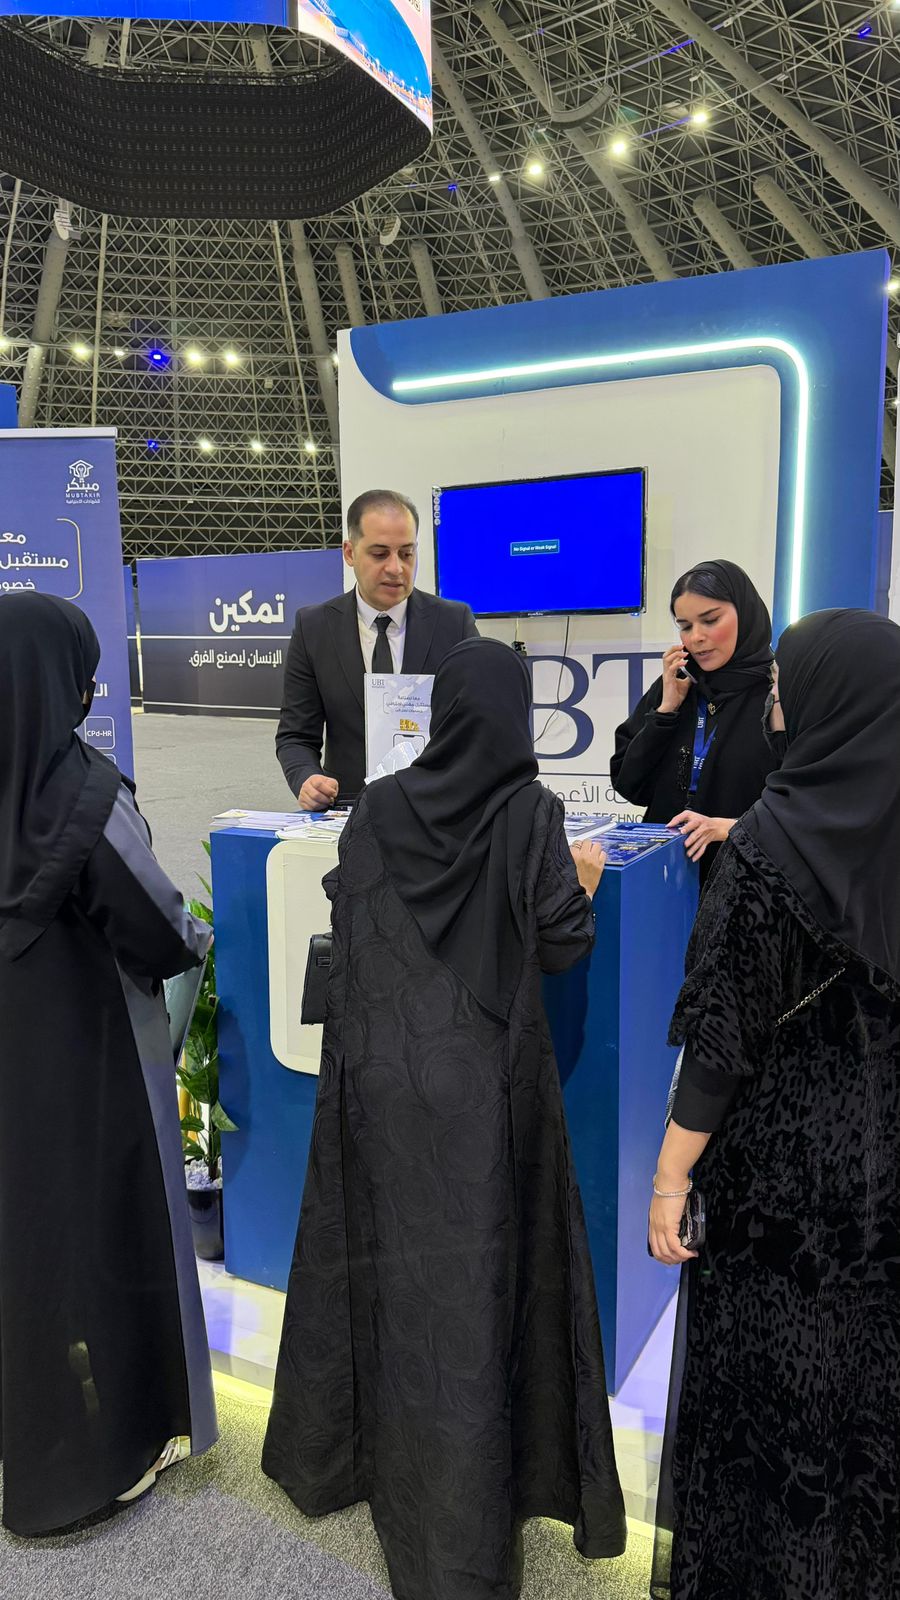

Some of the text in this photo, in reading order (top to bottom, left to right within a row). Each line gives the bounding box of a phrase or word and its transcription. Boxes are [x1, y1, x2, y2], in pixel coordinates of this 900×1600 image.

[65, 477, 100, 493] مبتكر
[0, 532, 27, 545] مع
[0, 551, 69, 571] مستقبل
[0, 578, 36, 592] خصو
[209, 590, 285, 633] تمكين
[216, 649, 246, 669] ليصنع
[247, 649, 282, 668] الإنسان
[542, 781, 600, 804] الأعم
